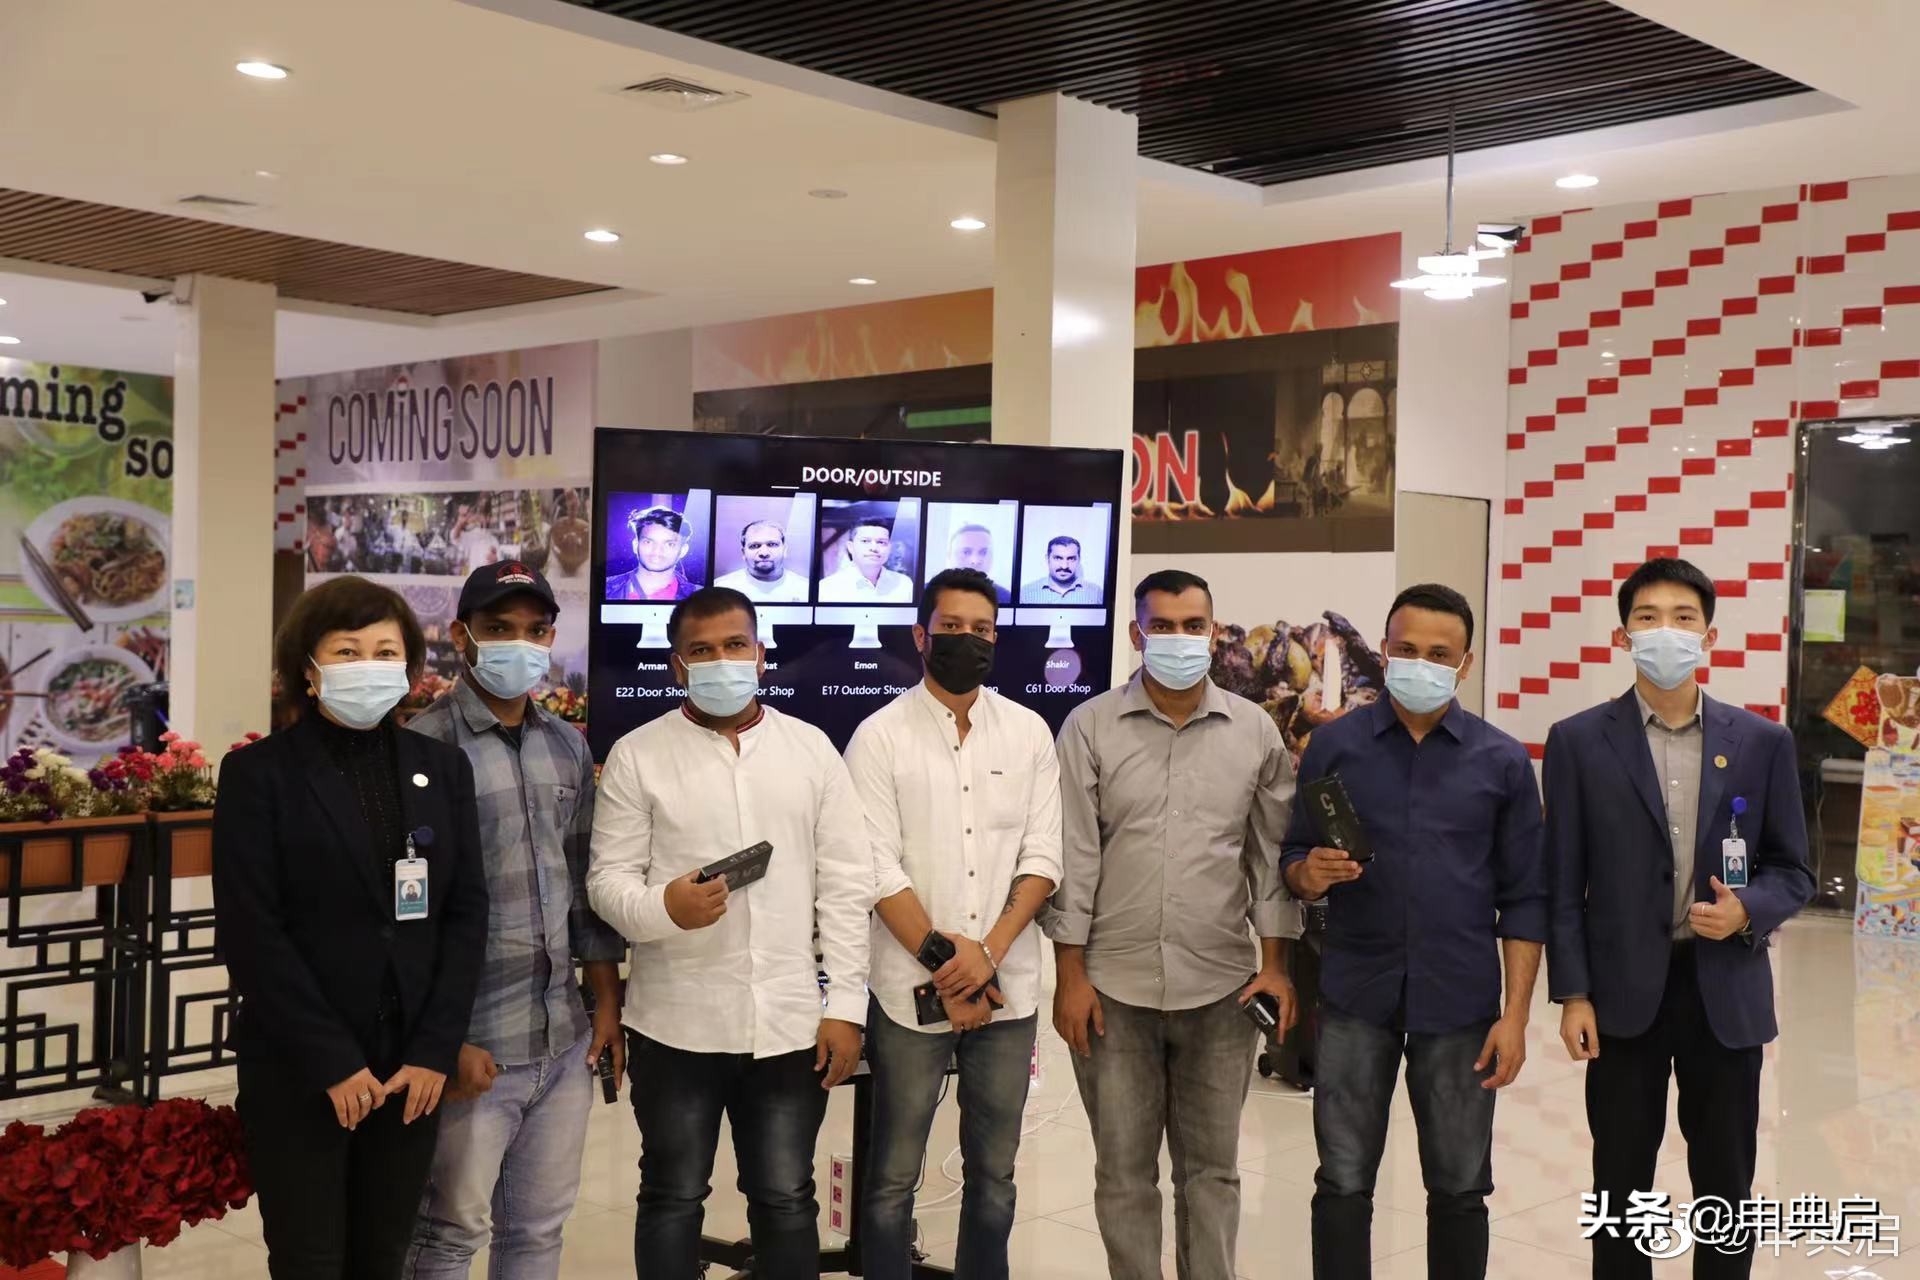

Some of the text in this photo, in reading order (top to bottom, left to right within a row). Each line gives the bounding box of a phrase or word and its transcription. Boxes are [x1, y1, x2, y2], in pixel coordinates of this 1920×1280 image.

[0, 365, 127, 442] ming
[459, 377, 553, 460] SOON
[125, 437, 174, 479] so
[802, 466, 942, 487] DOOR/OUTSIDE
[637, 662, 668, 671] Arman
[854, 661, 878, 670] Emon
[1046, 660, 1070, 669] Shakir
[616, 687, 635, 698] E22
[637, 687, 663, 697] Door
[769, 685, 795, 699] Shop
[822, 685, 840, 696] E17
[841, 685, 882, 695] Outdoor
[1025, 683, 1092, 695] C61 Door Shop
